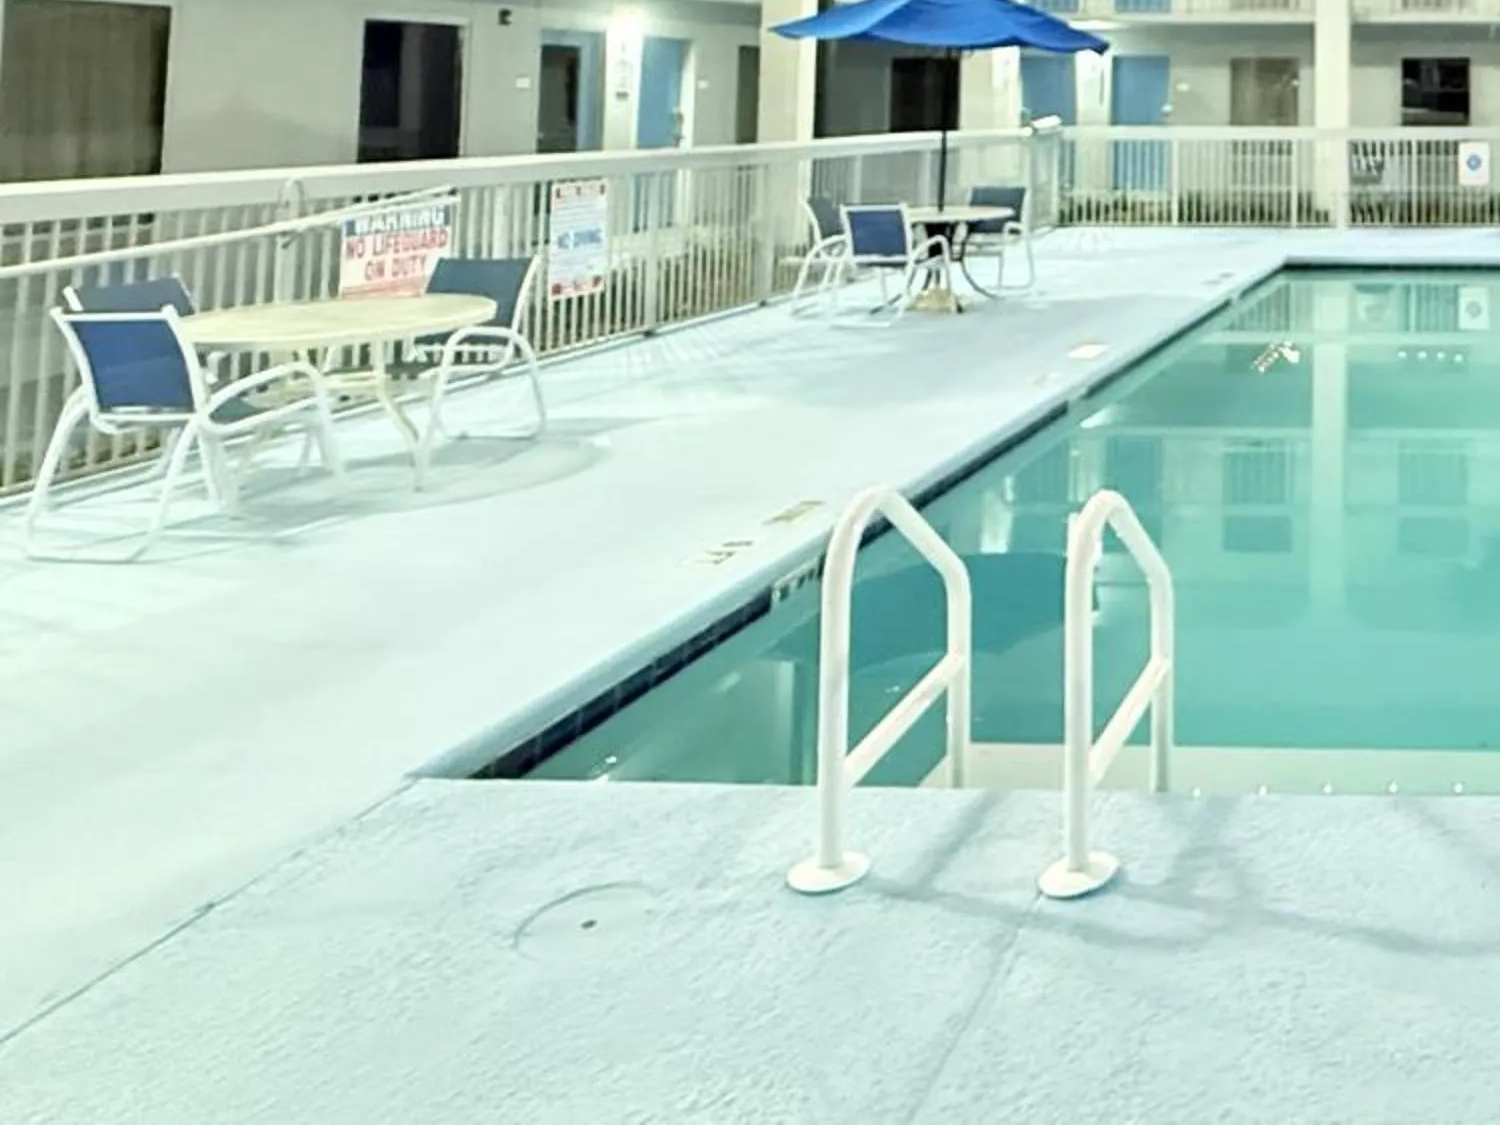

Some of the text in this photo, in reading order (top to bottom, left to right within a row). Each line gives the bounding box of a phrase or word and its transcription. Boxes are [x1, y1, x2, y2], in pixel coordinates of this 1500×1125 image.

[356, 204, 445, 234] WARNING
[345, 227, 449, 260] NO LIFEGUARD
[364, 254, 427, 281] ON DUTY
